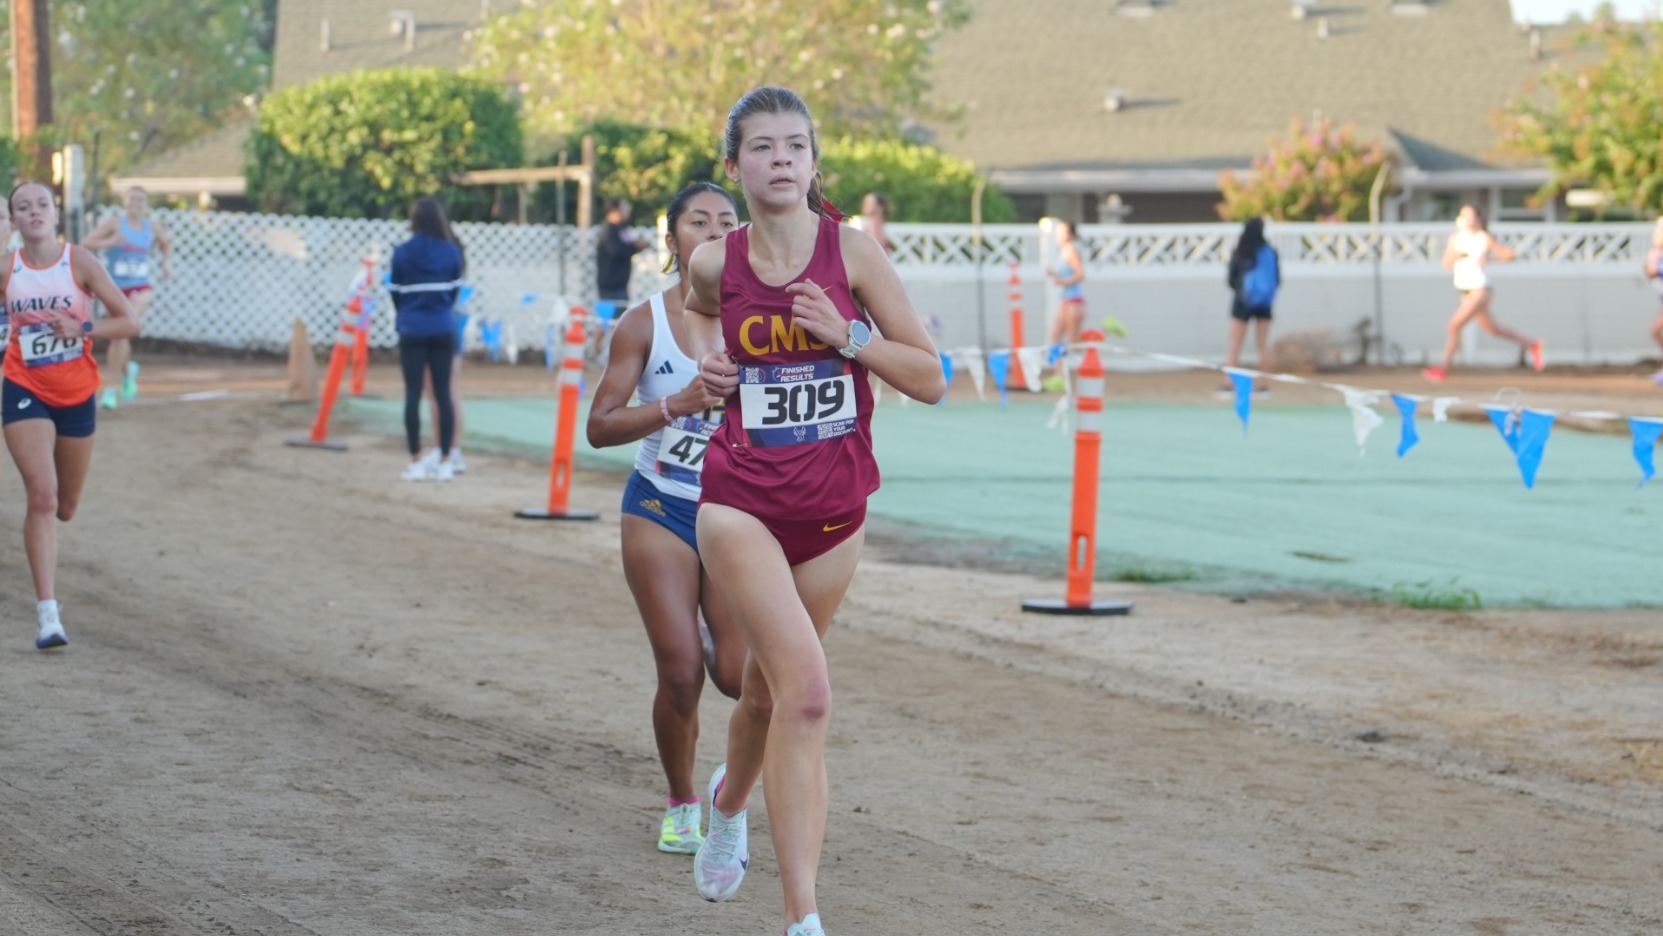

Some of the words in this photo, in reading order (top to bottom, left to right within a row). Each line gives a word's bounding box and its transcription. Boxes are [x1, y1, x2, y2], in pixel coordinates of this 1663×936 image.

[11, 295, 72, 313] WAVES
[739, 314, 829, 356] CM
[780, 373, 814, 382] RESULTS
[781, 365, 815, 374] FINISHED
[762, 379, 845, 425] 309
